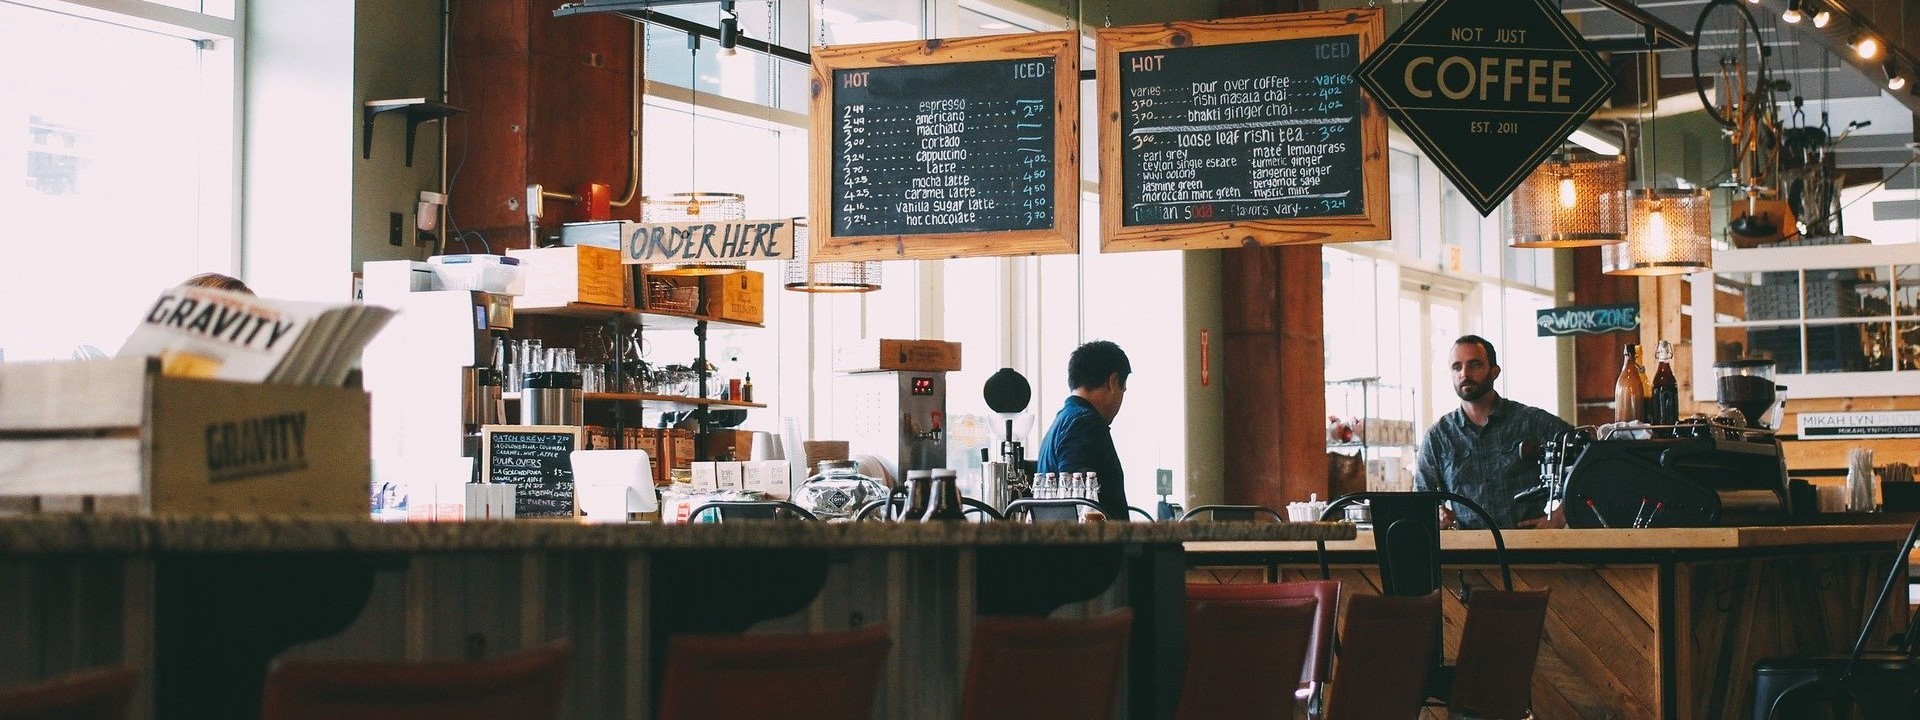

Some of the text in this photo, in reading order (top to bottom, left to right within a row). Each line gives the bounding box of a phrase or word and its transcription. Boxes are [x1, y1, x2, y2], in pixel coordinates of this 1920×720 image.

[1451, 27, 1527, 44] NOT JUST
[1315, 42, 1350, 60] ICED
[1014, 62, 1045, 79] ICED
[1131, 55, 1165, 72] HOT
[843, 72, 870, 89] HOT
[1130, 73, 1354, 97] varies pour over coffee varies
[1404, 56, 1572, 104] COFFEE
[1131, 87, 1342, 112] 370 rishi masala chai 402
[842, 104, 1044, 130] 249 americano 277
[843, 99, 966, 119] 249 espresso
[1131, 100, 1343, 125] 370 bhakti ginger chai 402
[843, 122, 965, 142] 300 macchiato
[1470, 121, 1518, 134] EST. 2011
[921, 135, 960, 150] cortado
[1177, 133, 1211, 147] loose
[1216, 129, 1240, 146] leaf
[1244, 128, 1275, 144] rishi
[1279, 127, 1305, 142] tea
[843, 149, 967, 167] 324 cappuccino
[1143, 149, 1188, 162] earl grey
[1287, 143, 1346, 157] lemongrass
[842, 154, 1047, 179] 370 latte 402
[1142, 157, 1238, 172] ceylon single estate
[1251, 155, 1323, 168] turmeric ginger
[912, 175, 941, 188] mocha
[944, 174, 970, 187] latte
[1022, 170, 1046, 182] 450
[1165, 169, 1196, 179] oolong
[1252, 165, 1332, 180] tangerine ginger
[1141, 180, 1203, 193] jasmine green
[1253, 176, 1321, 188] bergamot sage
[843, 183, 1046, 201] 425 caramel latte 450
[1142, 187, 1241, 202] moroccan mint green
[1253, 186, 1310, 199] mystic mint
[843, 197, 1046, 214] 416 vanilla sugar latte 450
[1273, 203, 1299, 217] vary
[1320, 199, 1346, 212] 324
[843, 211, 1046, 230] 324 hot chocolate 370
[630, 222, 786, 260] ORDER HERE
[147, 295, 295, 350] GRAVITY
[1551, 307, 1635, 329] WORK ZONE
[1803, 415, 1845, 426] MIKAH
[1849, 415, 1874, 425] LYN
[205, 411, 308, 471] GRAVITY
[521, 434, 546, 442] BREW
[493, 456, 542, 467] POUR OVERS
